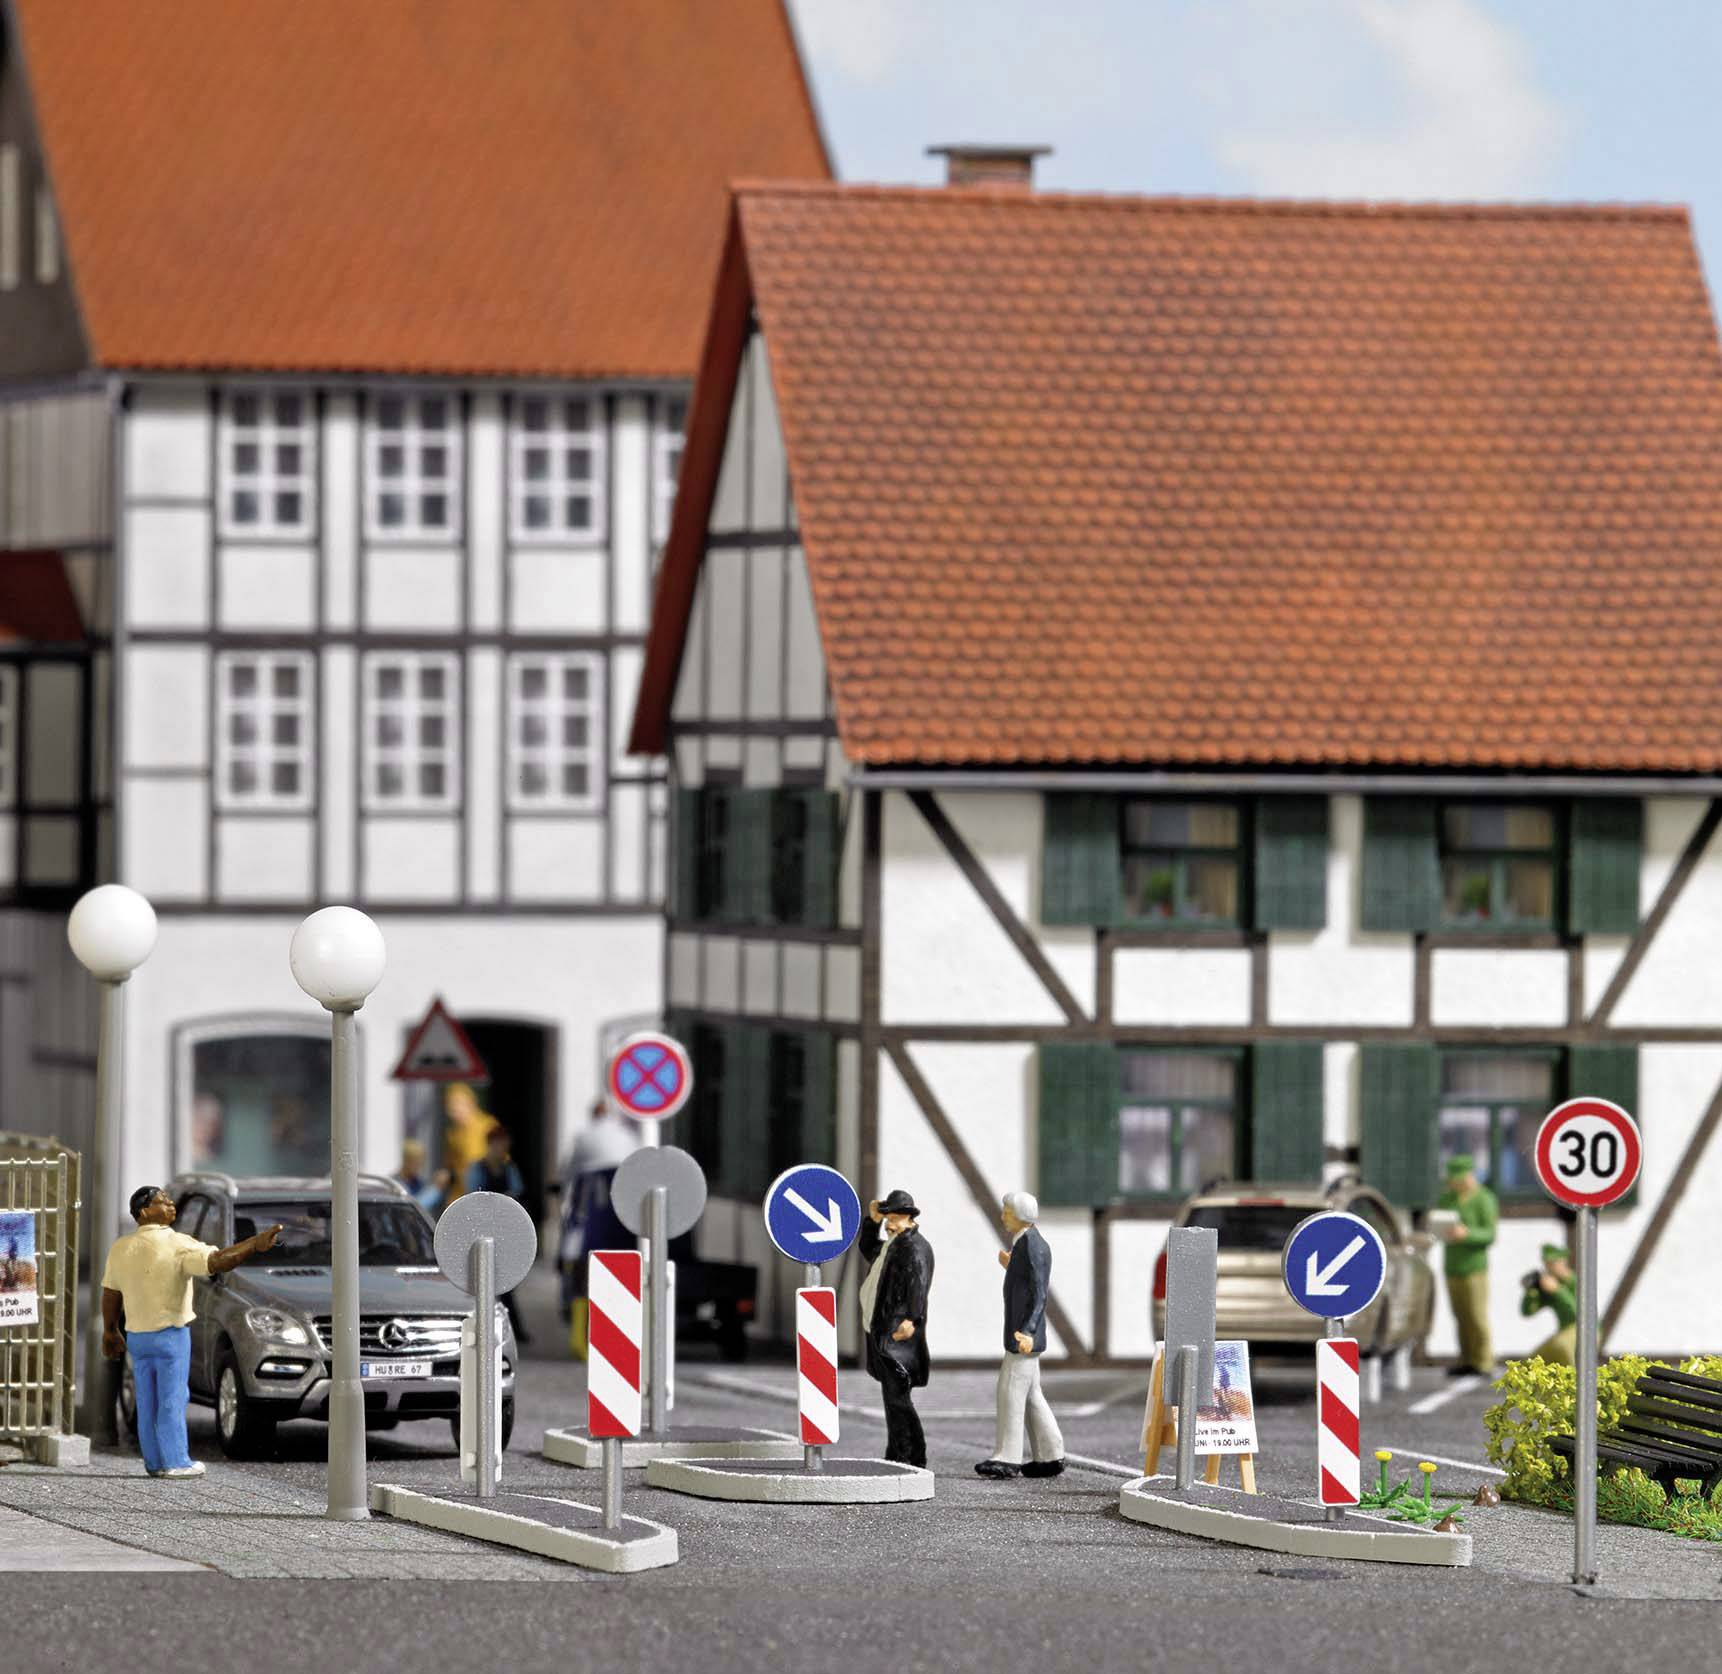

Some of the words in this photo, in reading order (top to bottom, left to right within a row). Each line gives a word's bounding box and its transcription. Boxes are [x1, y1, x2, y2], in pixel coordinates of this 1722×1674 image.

[1558, 1130, 1618, 1178] 30
[5, 1297, 19, 1306] Pub
[16, 1308, 33, 1316] UHR
[1221, 1427, 1236, 1435] Pub
[1233, 1438, 1250, 1446] UHR
